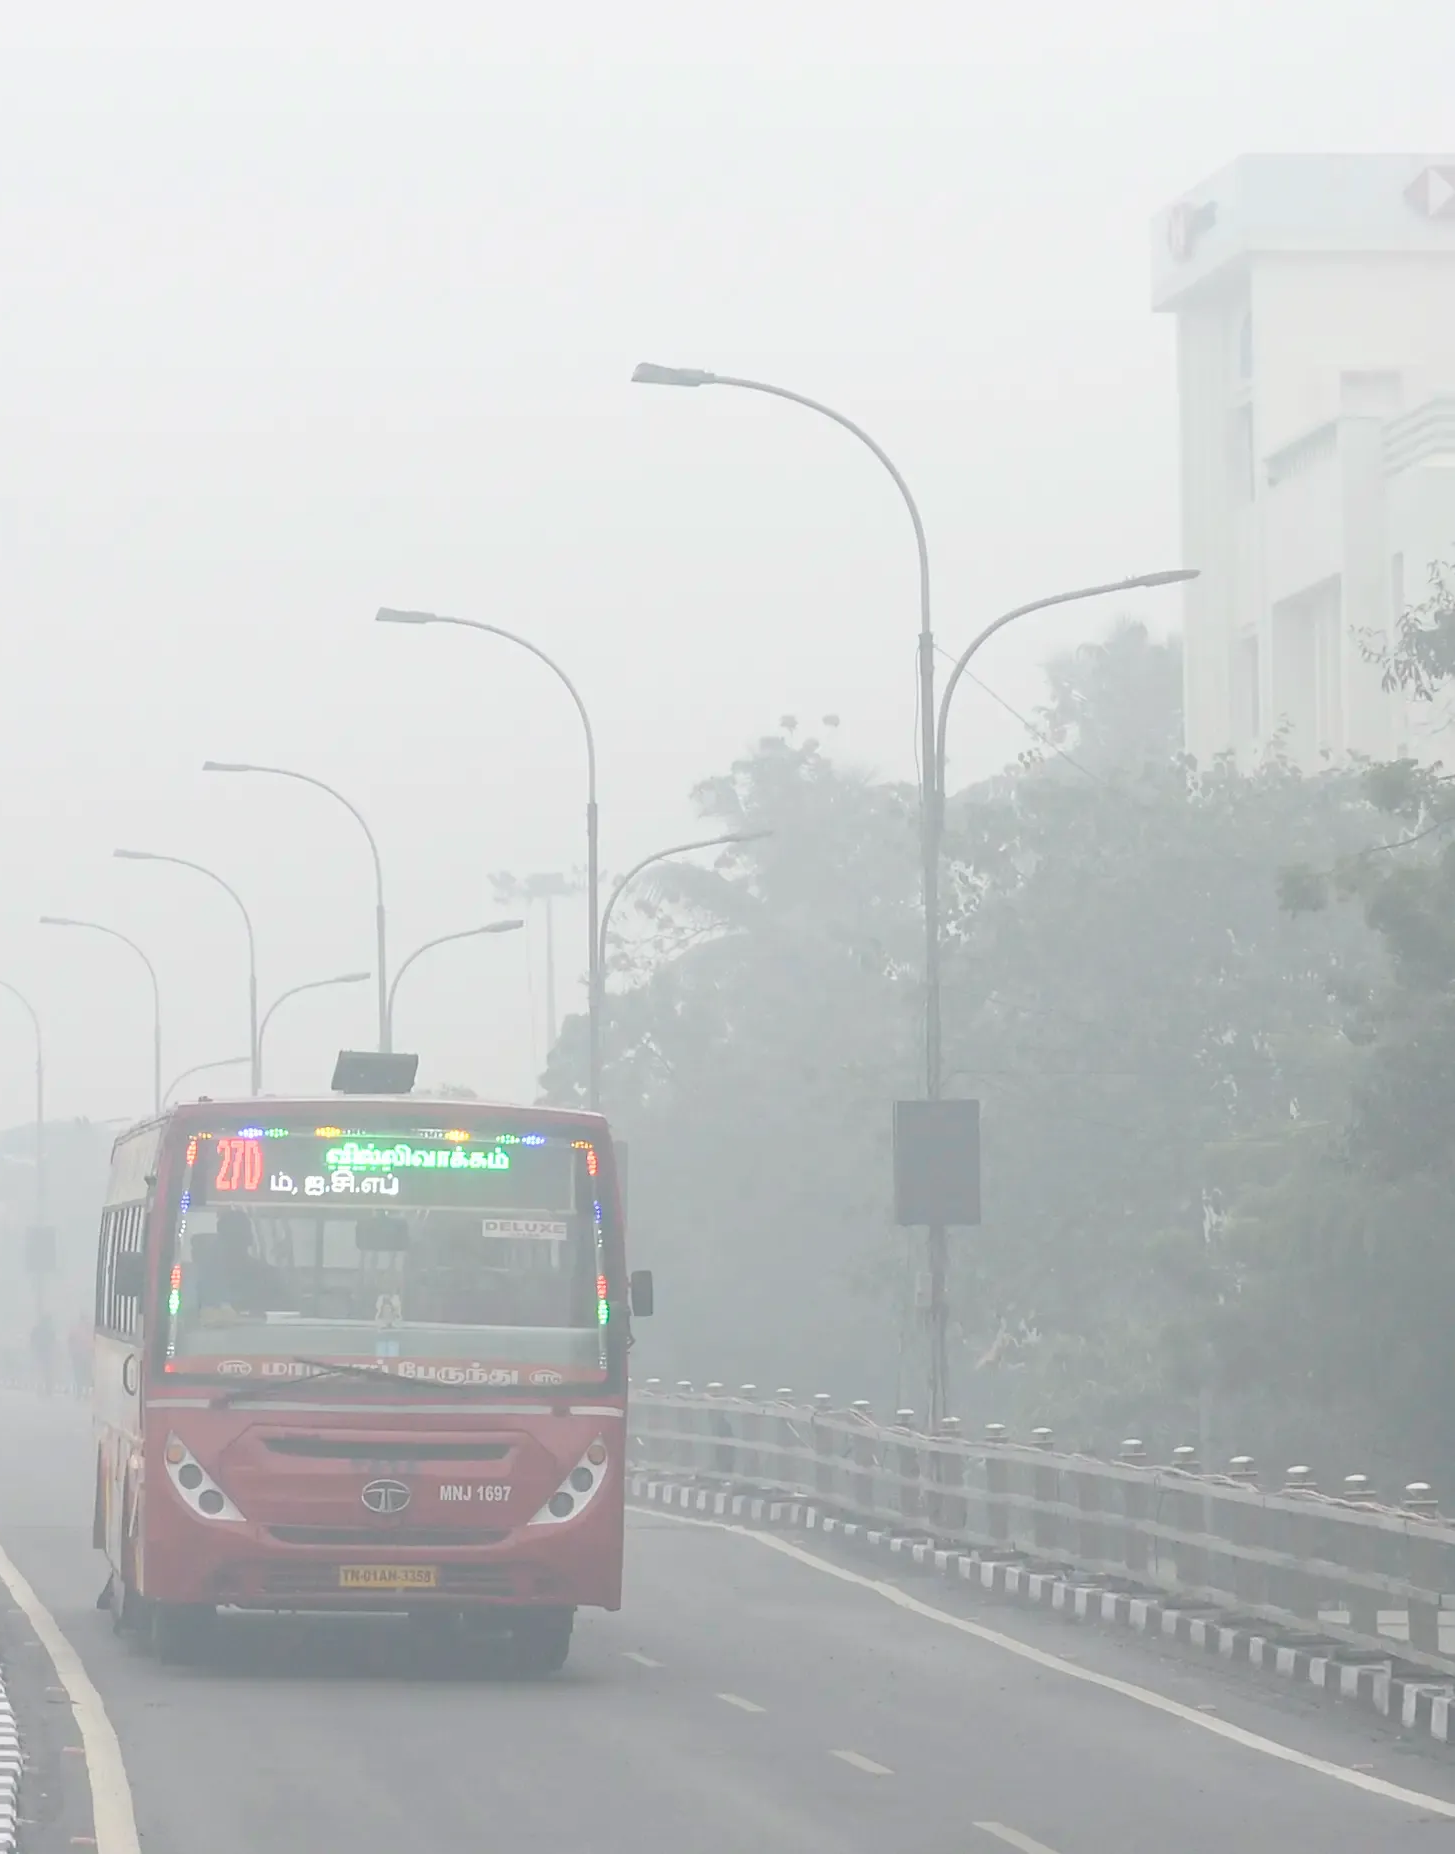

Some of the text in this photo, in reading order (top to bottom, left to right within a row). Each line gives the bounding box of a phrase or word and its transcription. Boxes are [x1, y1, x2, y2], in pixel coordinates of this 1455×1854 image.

[216, 1139, 263, 1190] 27D
[486, 1221, 565, 1234] DELUXE
[440, 1485, 512, 1501] MNJ 1697
